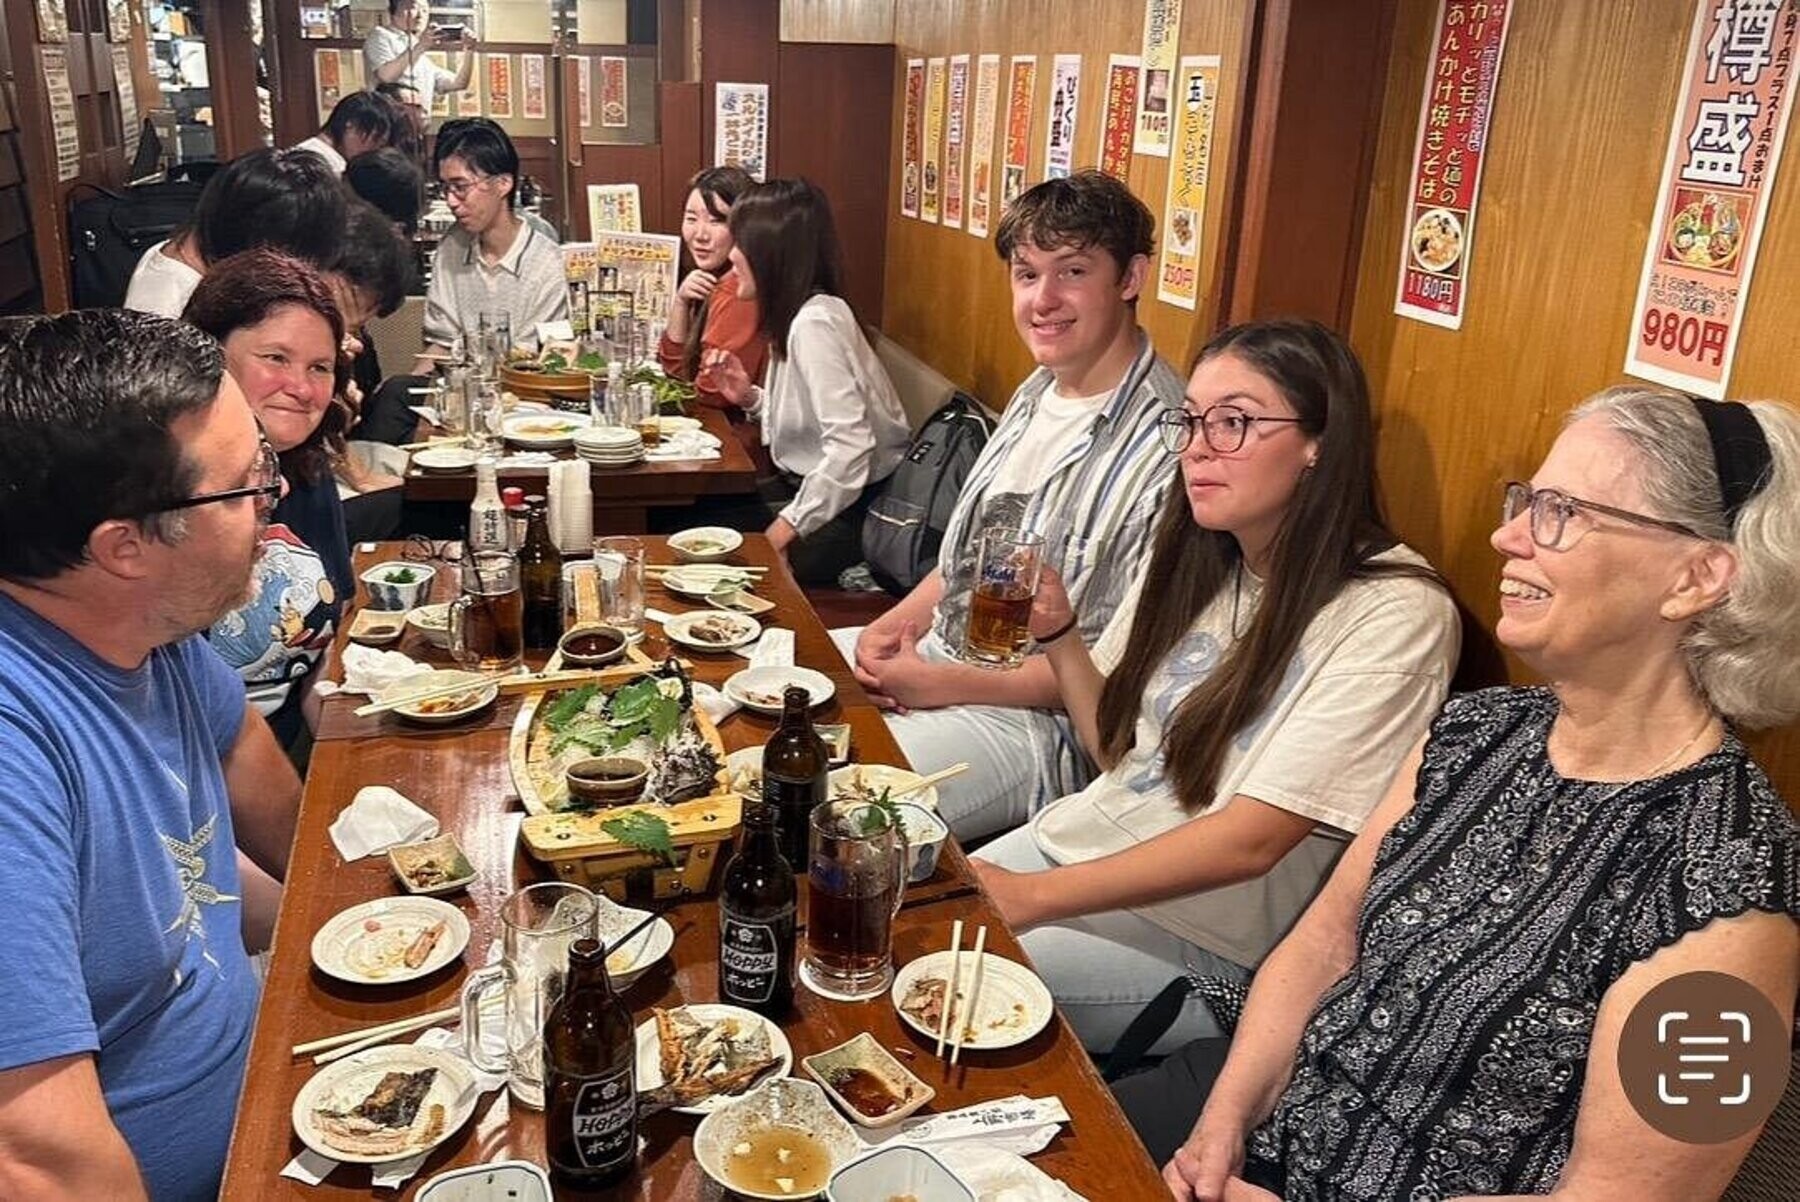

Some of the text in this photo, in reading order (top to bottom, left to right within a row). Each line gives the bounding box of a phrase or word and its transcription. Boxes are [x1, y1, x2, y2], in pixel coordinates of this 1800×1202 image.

[1418, 4, 1465, 199] あんかけ焼きそば
[1439, 1, 1489, 204] カリッとモチッと麺の
[1680, 0, 1783, 187] 樽盛
[1407, 271, 1454, 303] 1180円
[1643, 308, 1729, 367] 980円
